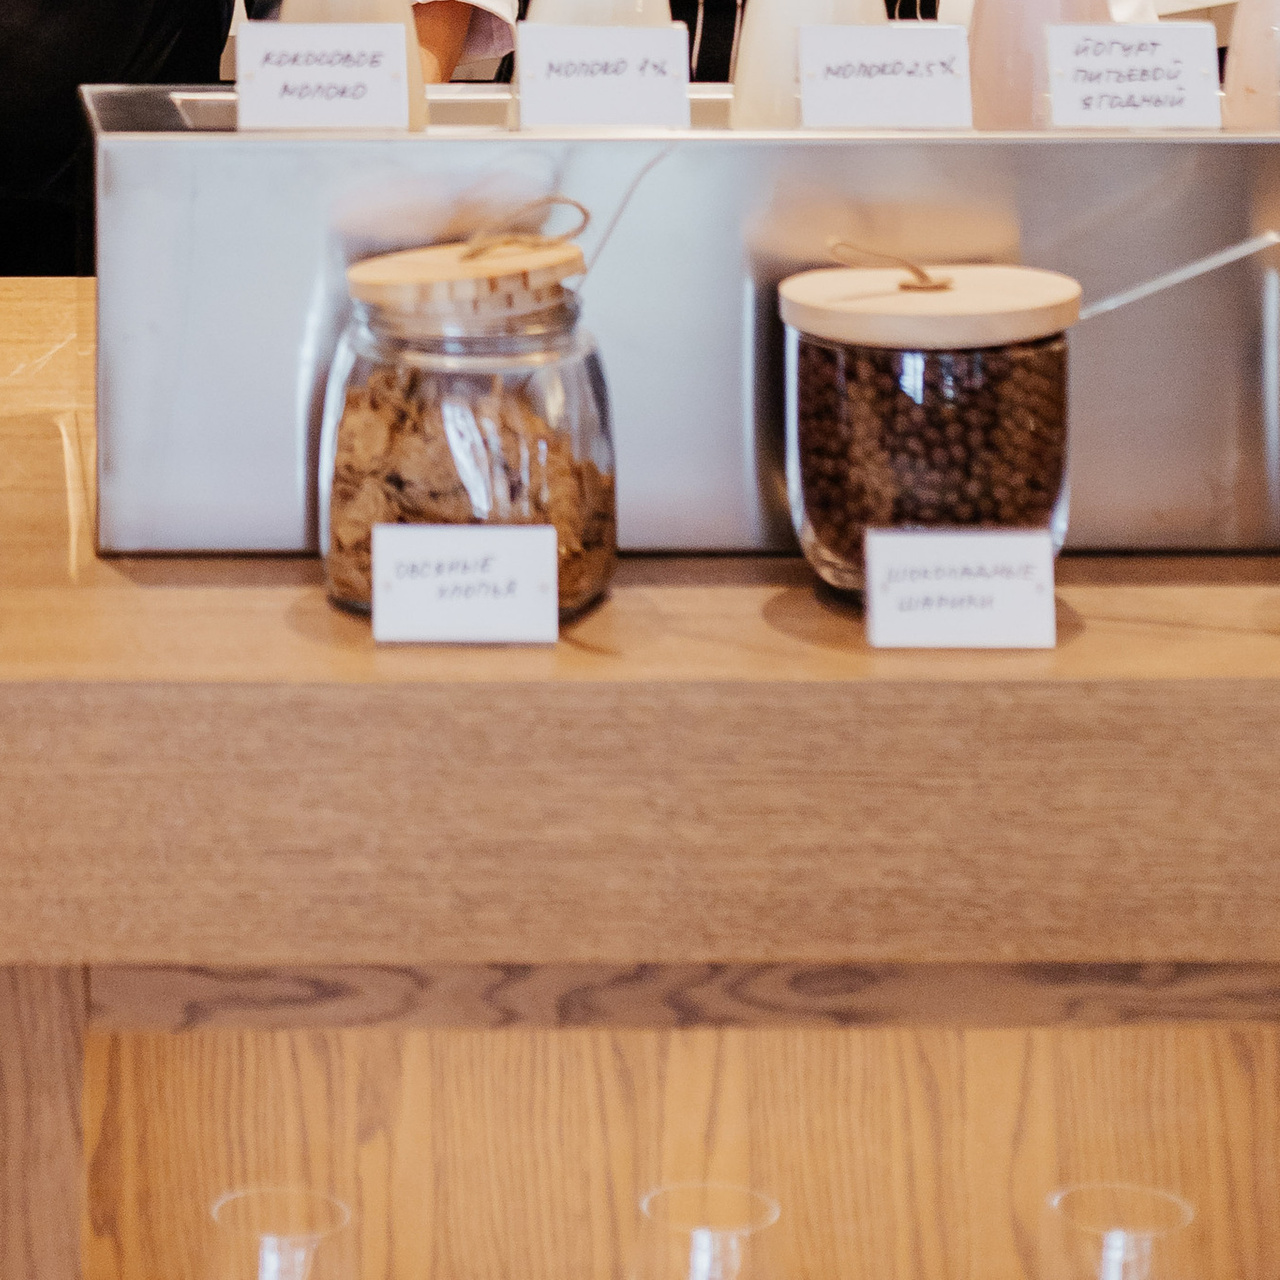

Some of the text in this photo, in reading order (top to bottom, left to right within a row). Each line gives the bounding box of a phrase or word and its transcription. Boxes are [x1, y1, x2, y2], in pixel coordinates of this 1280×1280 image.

[1073, 37, 1162, 57] ЙОГУРТ
[545, 58, 629, 80] МОЛОКО
[1073, 58, 1183, 83] ПИТЬЕВОЙ
[279, 81, 368, 101] МОЛОКО
[1081, 85, 1186, 110] ЯГОДНЫЙ
